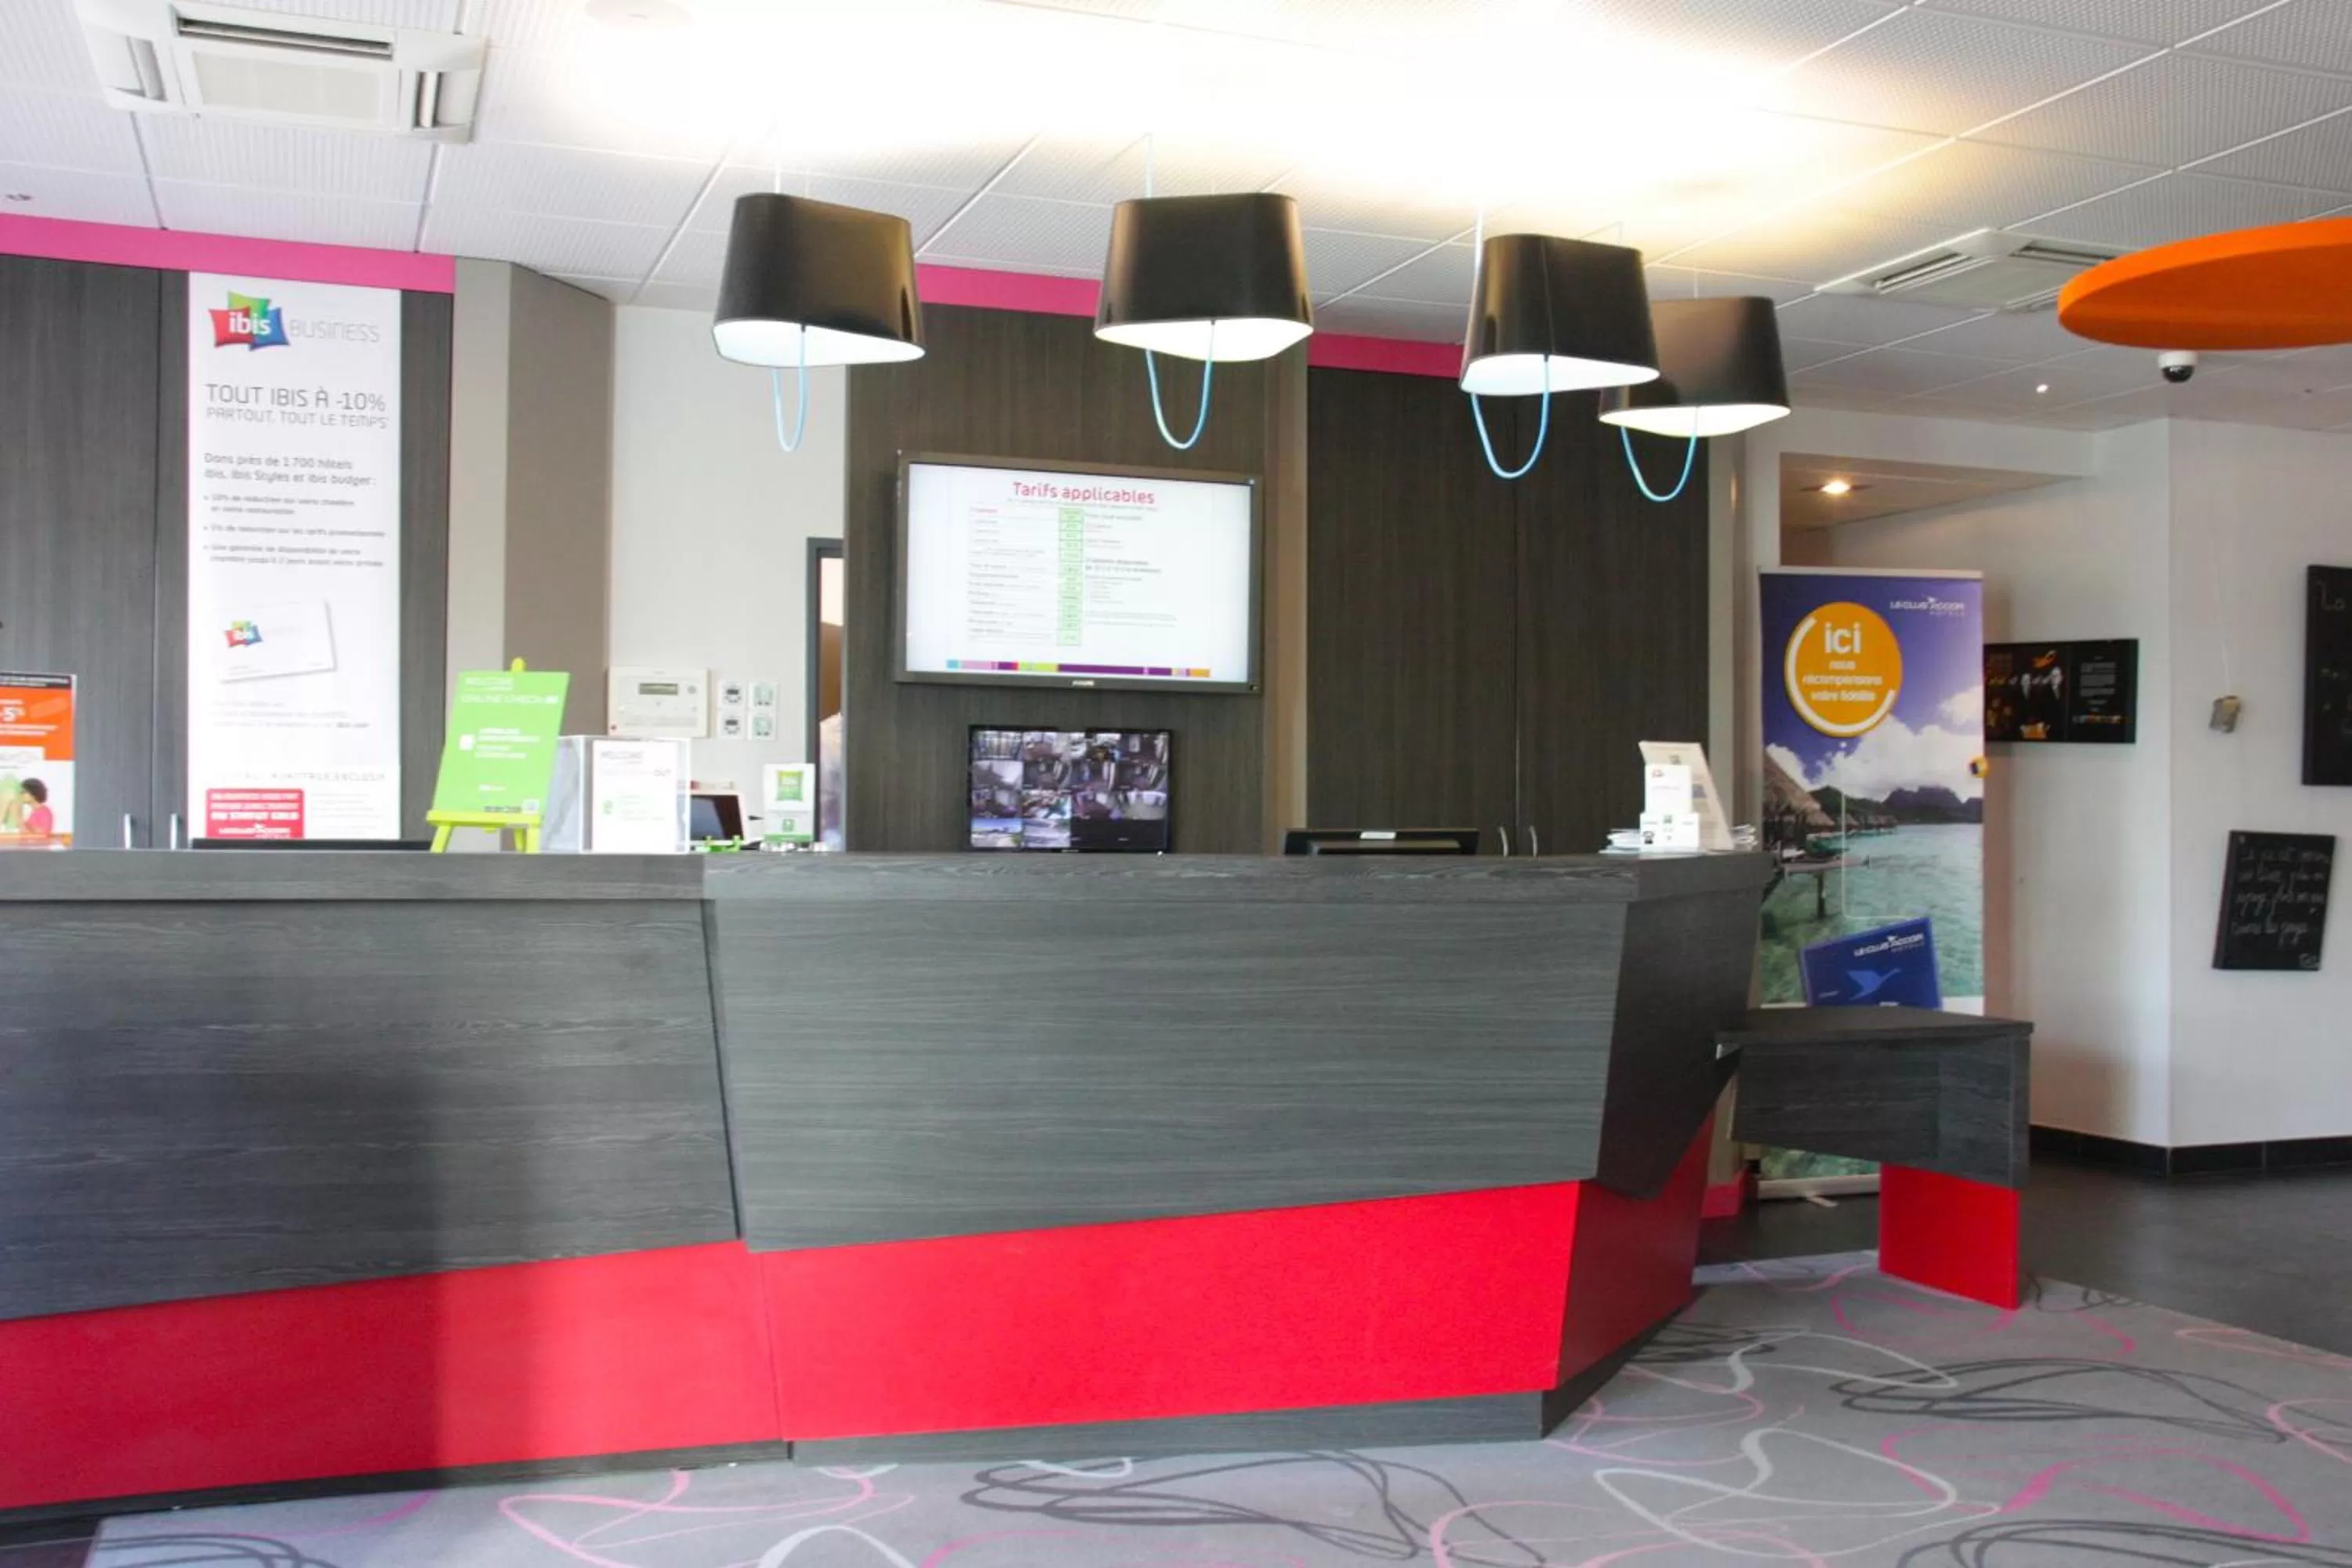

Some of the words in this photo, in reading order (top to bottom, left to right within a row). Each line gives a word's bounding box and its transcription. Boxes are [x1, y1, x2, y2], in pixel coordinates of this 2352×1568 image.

[229, 311, 272, 336] ibis
[289, 319, 380, 343] BUSINESS
[206, 383, 264, 405] TOUT
[270, 388, 309, 408] IBIS
[315, 386, 329, 409] À
[336, 392, 387, 412] -10%
[280, 411, 316, 425] TOUT
[320, 413, 336, 426] LE
[340, 414, 389, 429] TEMPS
[1013, 481, 1058, 499] Tarifs
[1061, 486, 1155, 504] applicables
[1824, 621, 1862, 655] ici
